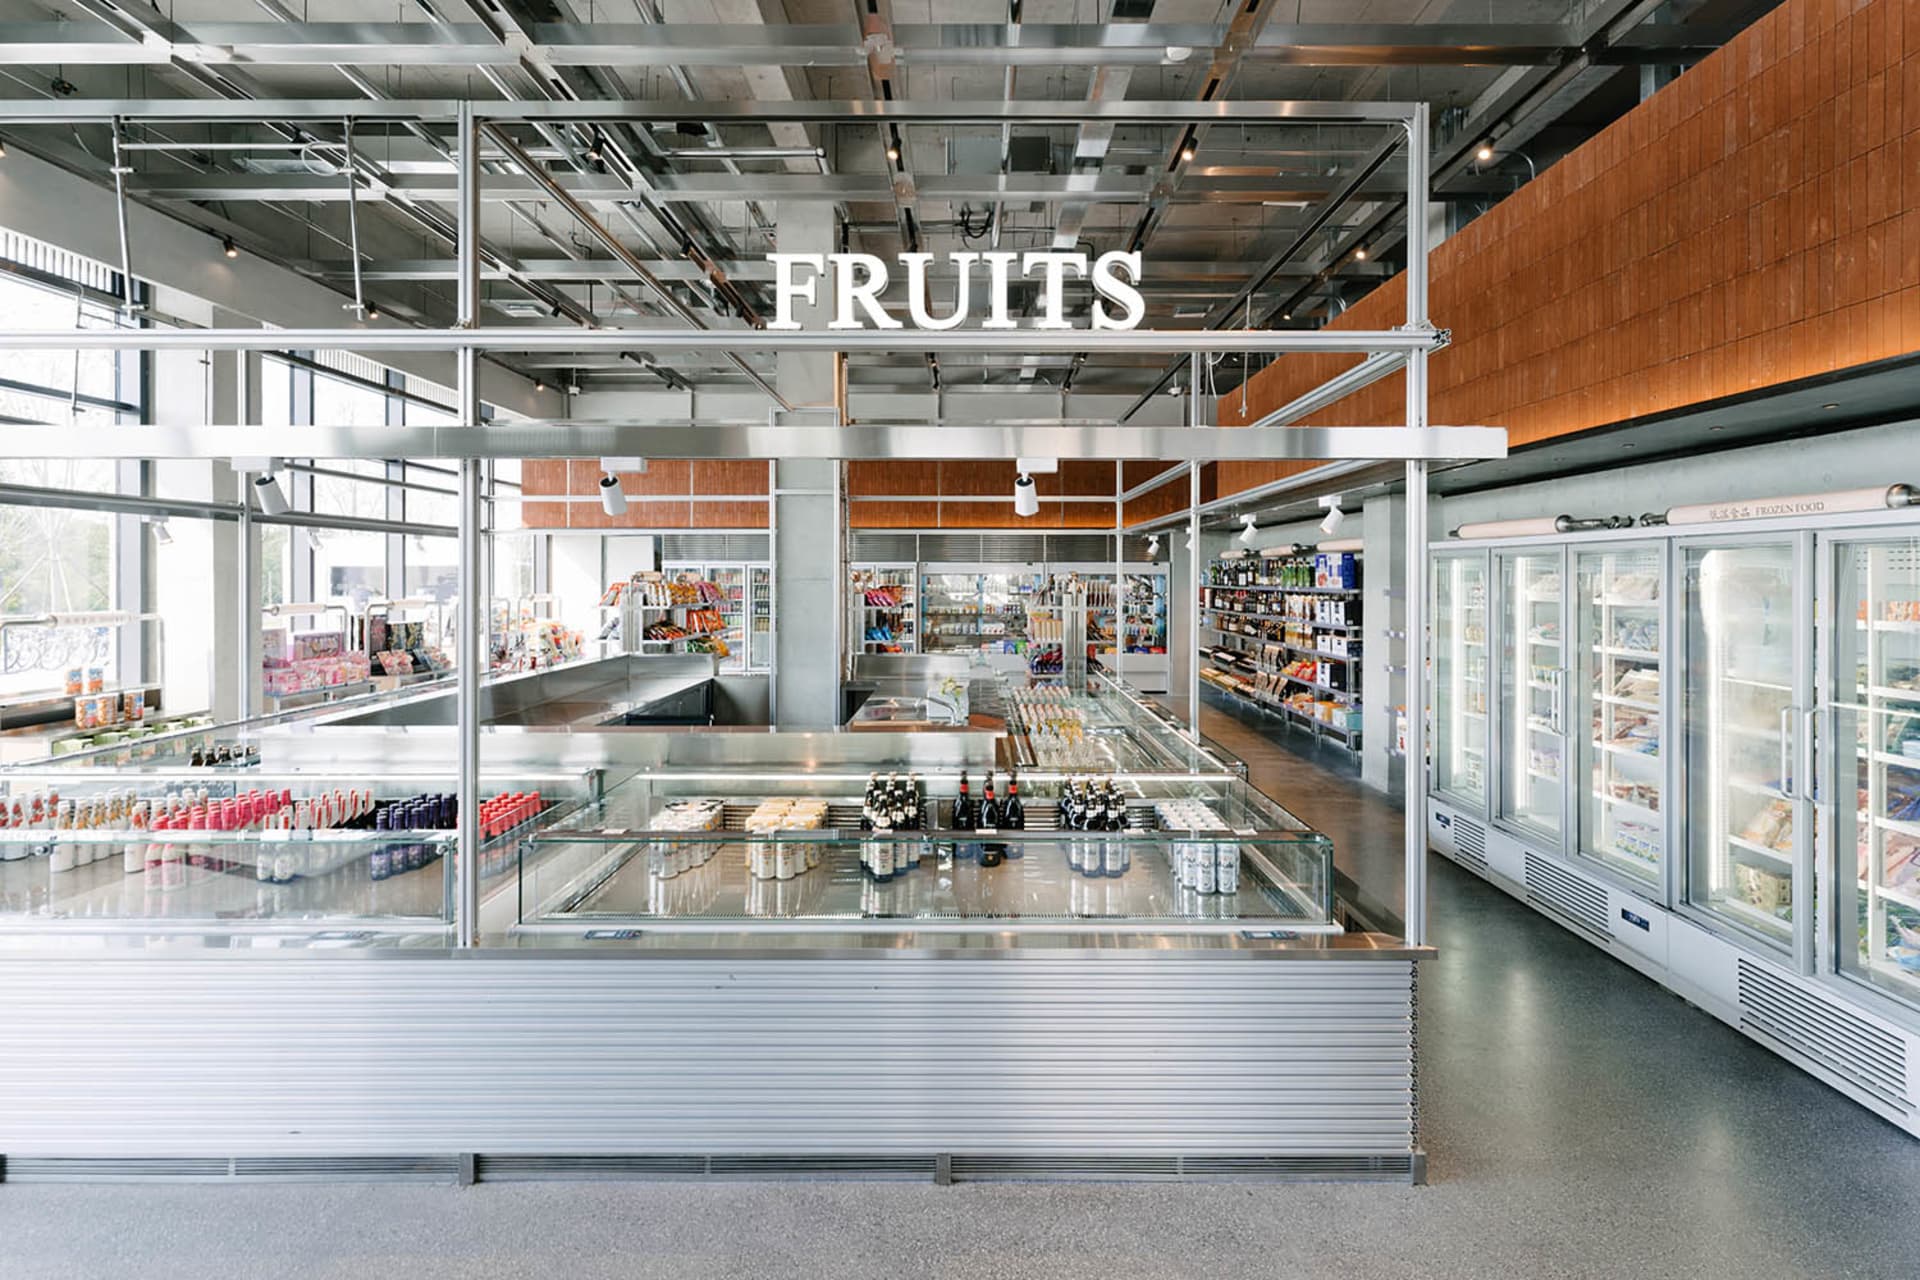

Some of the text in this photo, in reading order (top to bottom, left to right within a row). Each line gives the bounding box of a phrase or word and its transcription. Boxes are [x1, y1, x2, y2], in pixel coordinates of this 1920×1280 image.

[766, 251, 1145, 330] FRUITS
[1756, 501, 1825, 516] FROZEN FOOD
